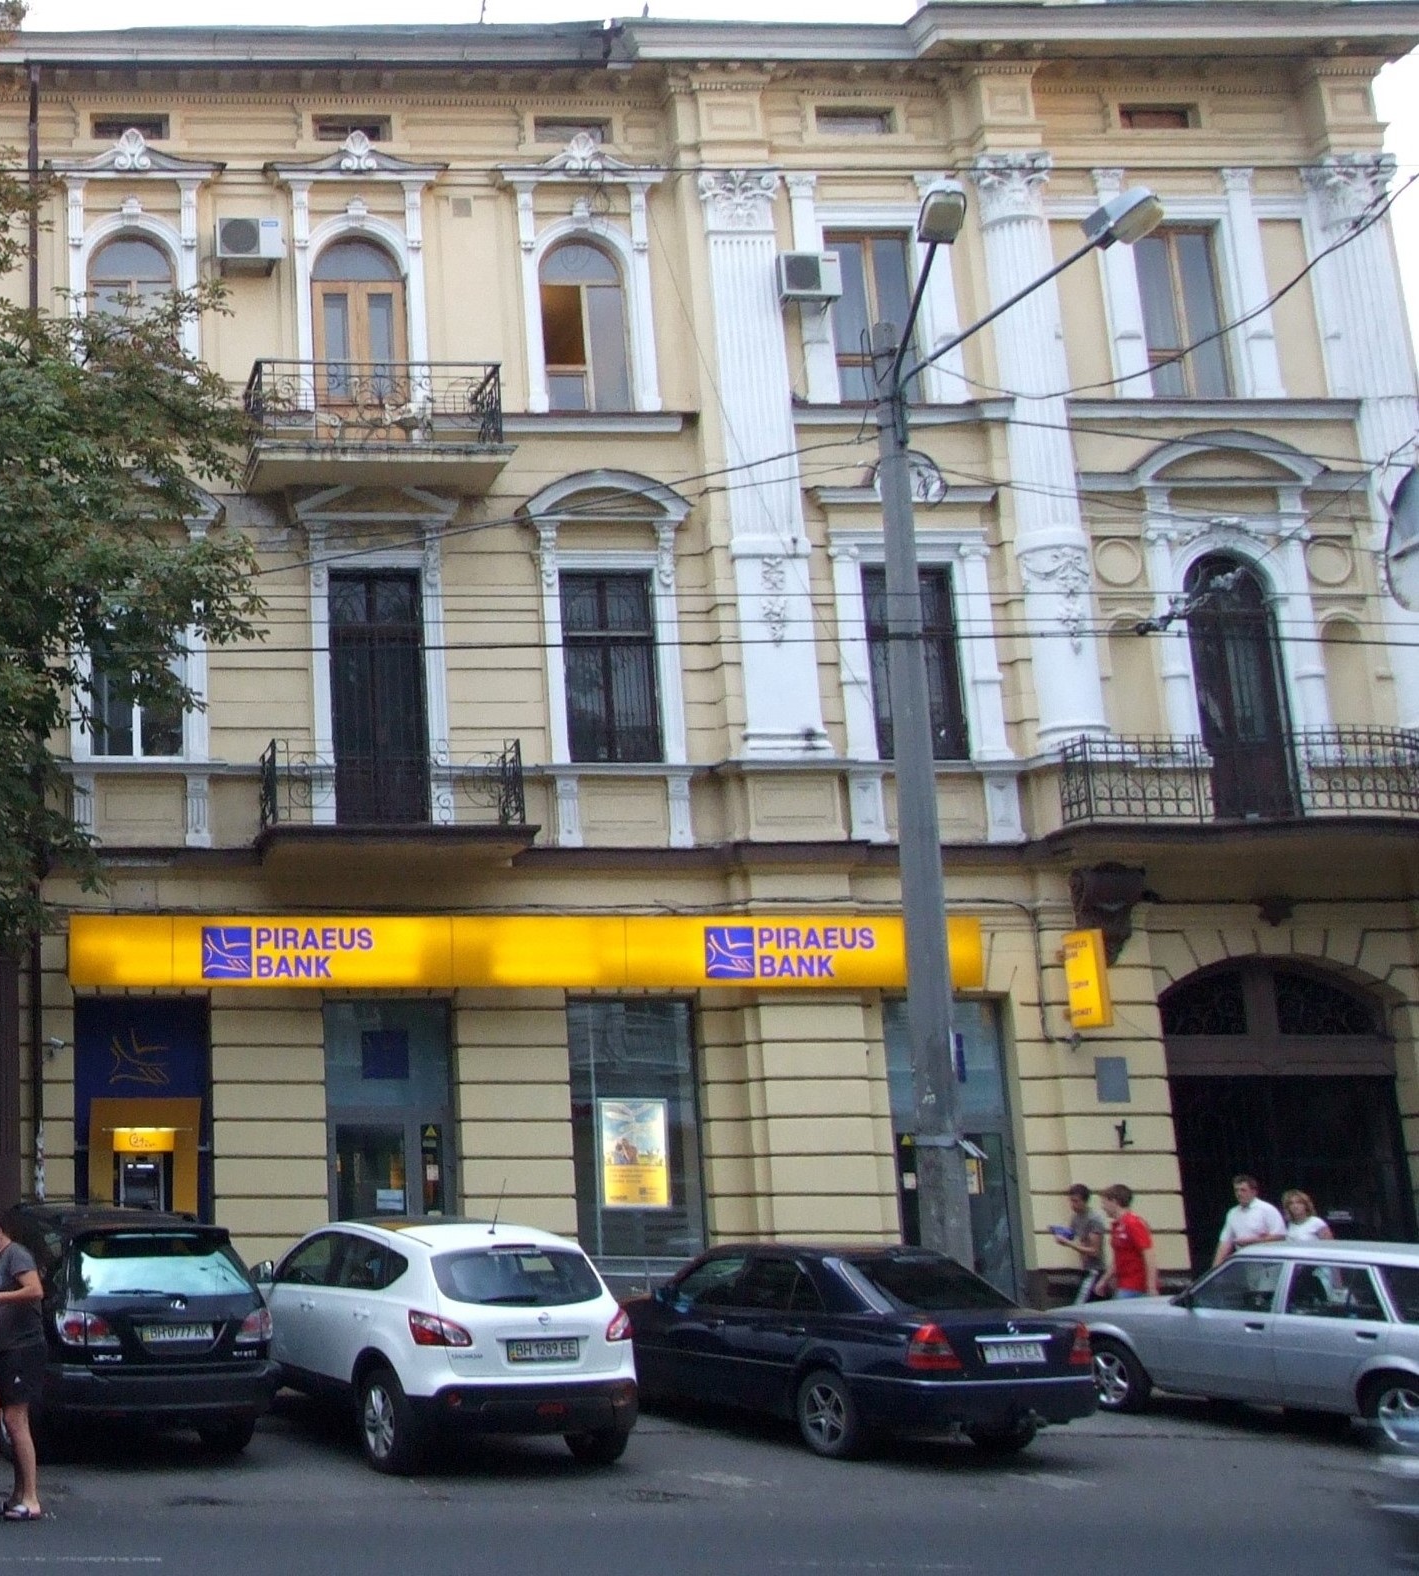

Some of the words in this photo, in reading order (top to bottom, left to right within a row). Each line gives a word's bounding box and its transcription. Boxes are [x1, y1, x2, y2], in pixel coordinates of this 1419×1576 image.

[256, 927, 374, 950] PIRAEUS
[758, 927, 875, 950] PIRAEUS
[256, 955, 332, 978] BANK
[759, 955, 835, 978] BANK
[515, 1341, 532, 1357] BH
[561, 1341, 576, 1356] EE
